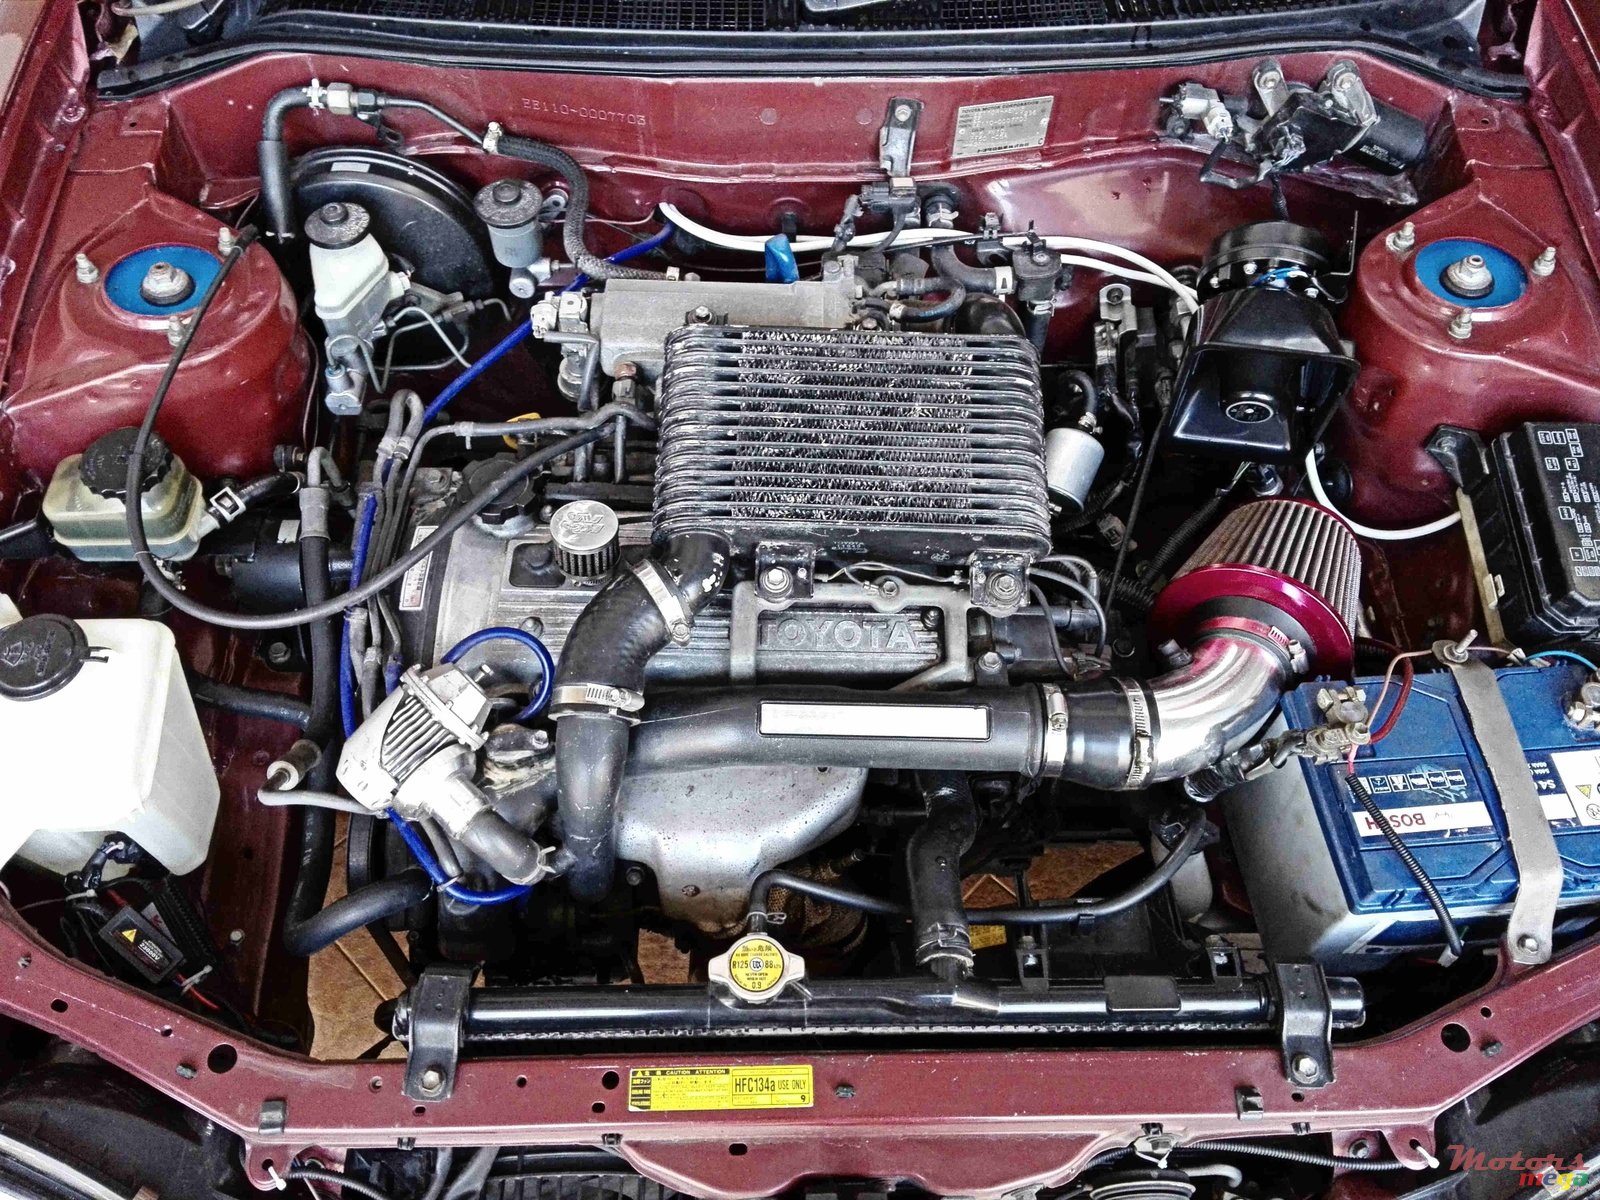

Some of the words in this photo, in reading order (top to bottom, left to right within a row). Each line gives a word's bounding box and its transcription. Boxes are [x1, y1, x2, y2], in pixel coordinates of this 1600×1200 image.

[758, 618, 918, 651] TOYOTA
[1364, 813, 1427, 830] BOSH
[732, 960, 749, 969] R125
[734, 1077, 776, 1093] HFC134a
[777, 1079, 790, 1090] USE
[791, 1079, 807, 1090] ONLY
